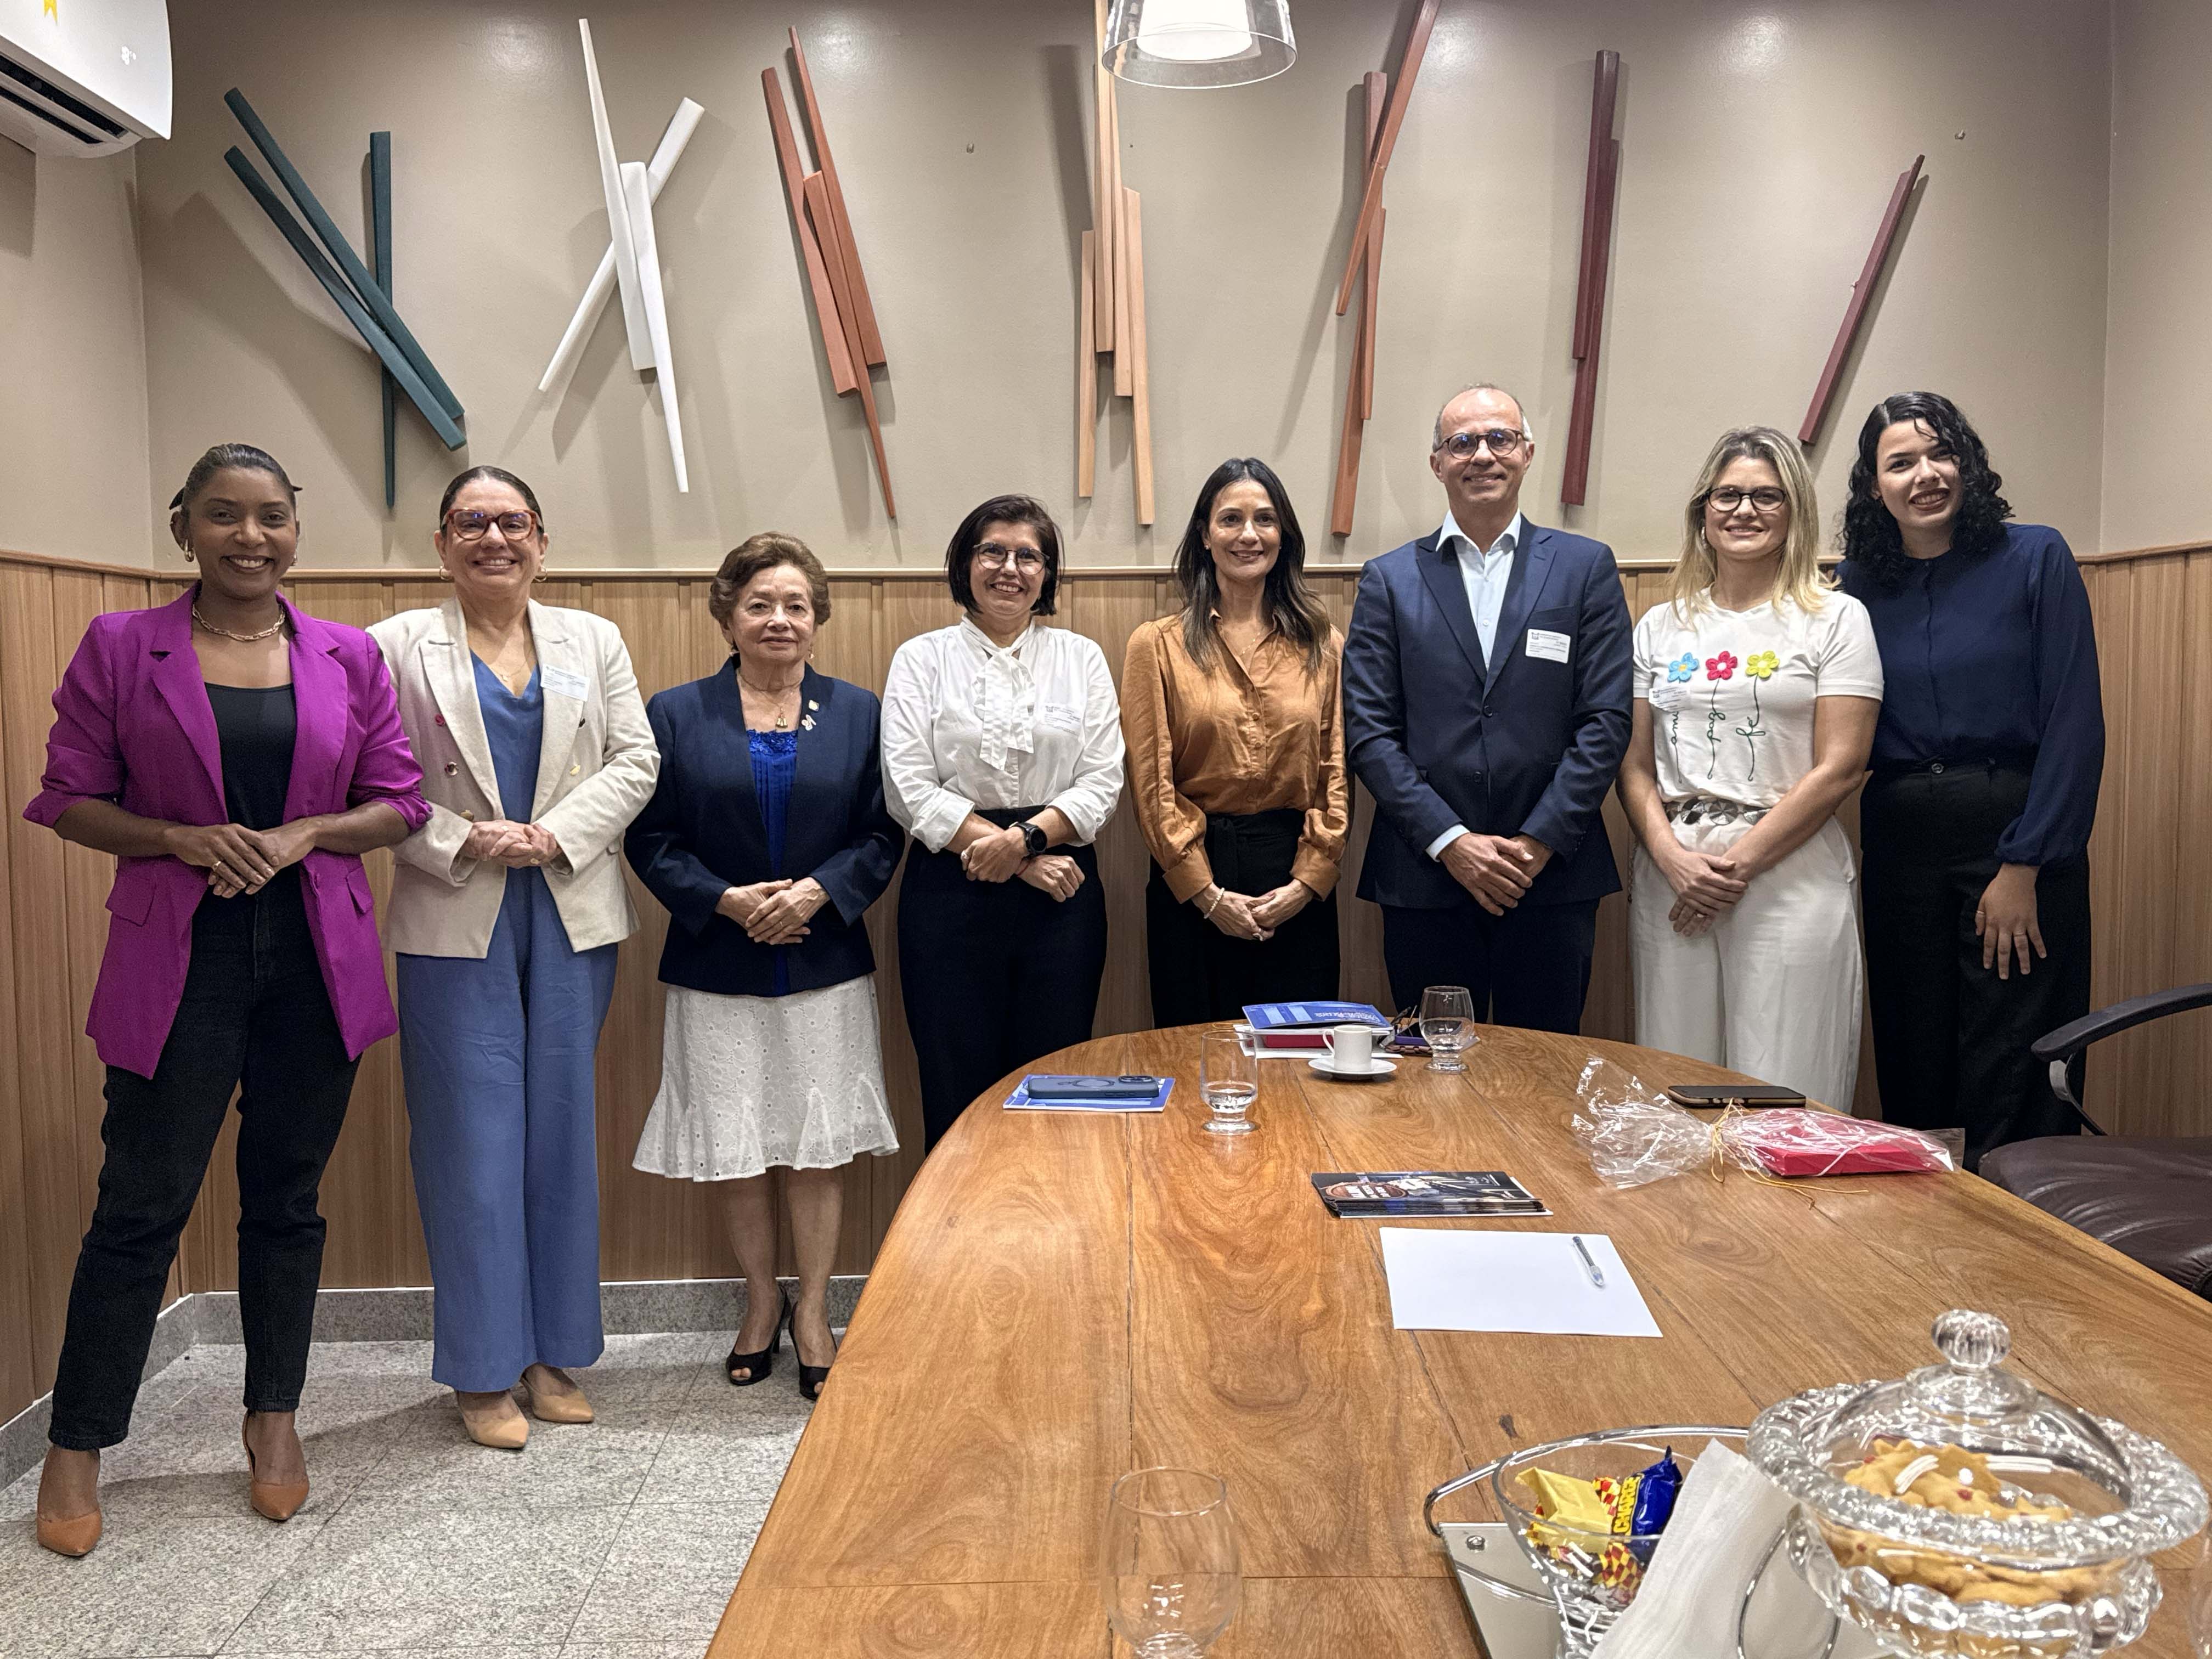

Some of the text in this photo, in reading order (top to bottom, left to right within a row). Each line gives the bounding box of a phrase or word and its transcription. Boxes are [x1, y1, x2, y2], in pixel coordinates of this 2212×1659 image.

[1707, 712, 1726, 742] paz
[1736, 716, 1766, 736] fé
[1613, 1476, 1641, 1533] CHARGE
